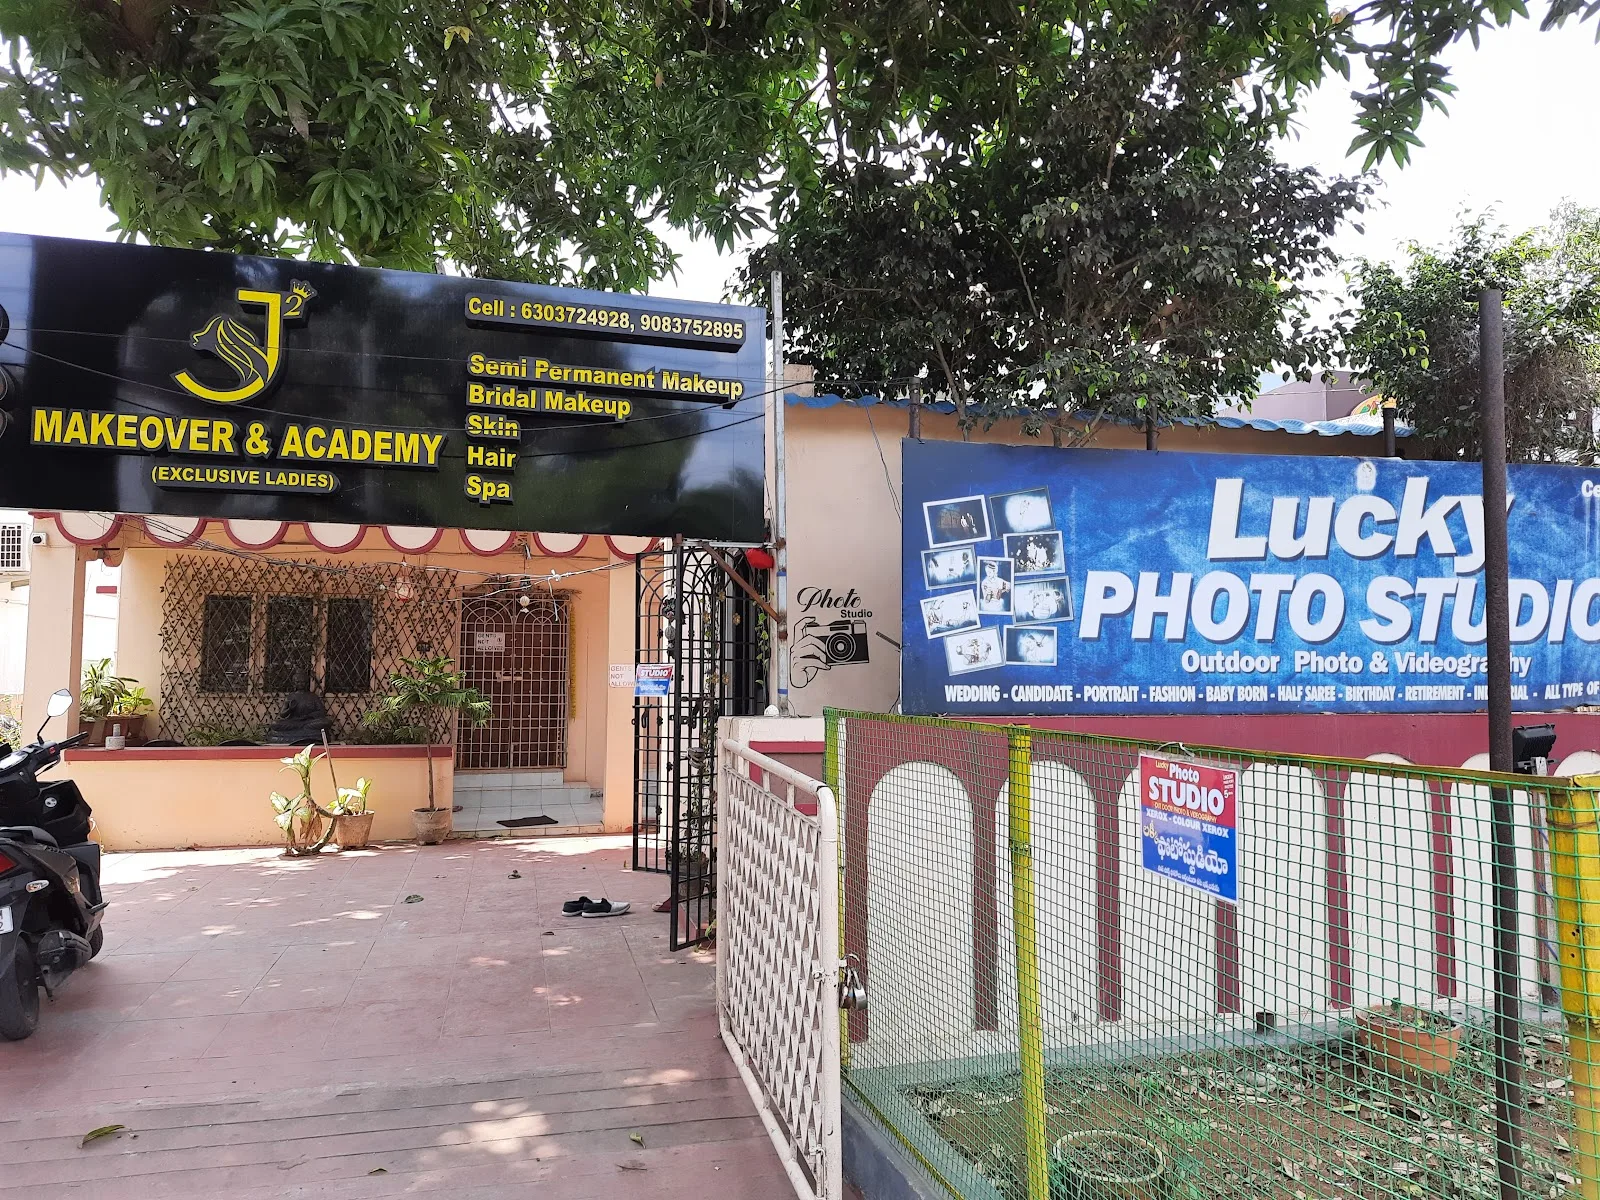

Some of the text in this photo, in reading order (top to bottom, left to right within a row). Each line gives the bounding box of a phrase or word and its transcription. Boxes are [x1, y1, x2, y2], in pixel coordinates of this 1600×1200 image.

[468, 297, 505, 317] Cell
[520, 302, 635, 332] 6303724928,
[640, 315, 744, 339] 9083752895
[469, 354, 743, 399] Semi Permanent Makeup
[468, 384, 631, 419] Bridal Makeup
[33, 408, 443, 465] MAKEOVER & ACADEMY
[468, 415, 518, 437] Skin
[467, 446, 516, 467] Hair
[151, 465, 334, 491] (EXCLUSIVE LADIES)
[467, 475, 510, 500] Spa
[796, 586, 862, 613] Photo
[1078, 570, 1345, 643] PHOTO
[840, 609, 873, 619] Studio
[640, 669, 668, 677] STUDIO
[1181, 649, 1532, 678] Outdoor Photo & Videograhy
[944, 684, 1000, 702] WEDDING
[1010, 684, 1073, 702] CANDIDATE
[1083, 685, 1139, 702] PORTRAIT
[1149, 685, 1196, 702] FASHION
[1206, 685, 1235, 702] BABY
[1237, 685, 1268, 702] BORN
[1277, 685, 1303, 702] HALF
[1304, 685, 1336, 702] SAREE
[1345, 685, 1396, 702] BIRTHDAY
[1404, 685, 1465, 701] RETIREMENT
[1544, 684, 1561, 700] ALL
[1562, 682, 1584, 698] TYPE
[1155, 760, 1200, 783] Lucky Photo
[1148, 775, 1225, 817] STUDIO
[1146, 808, 1168, 822] XEROX
[1172, 815, 1201, 831] COLOUR
[1201, 823, 1230, 839] XEROX
[1189, 811, 1218, 823] VIDEOGRAPHY
